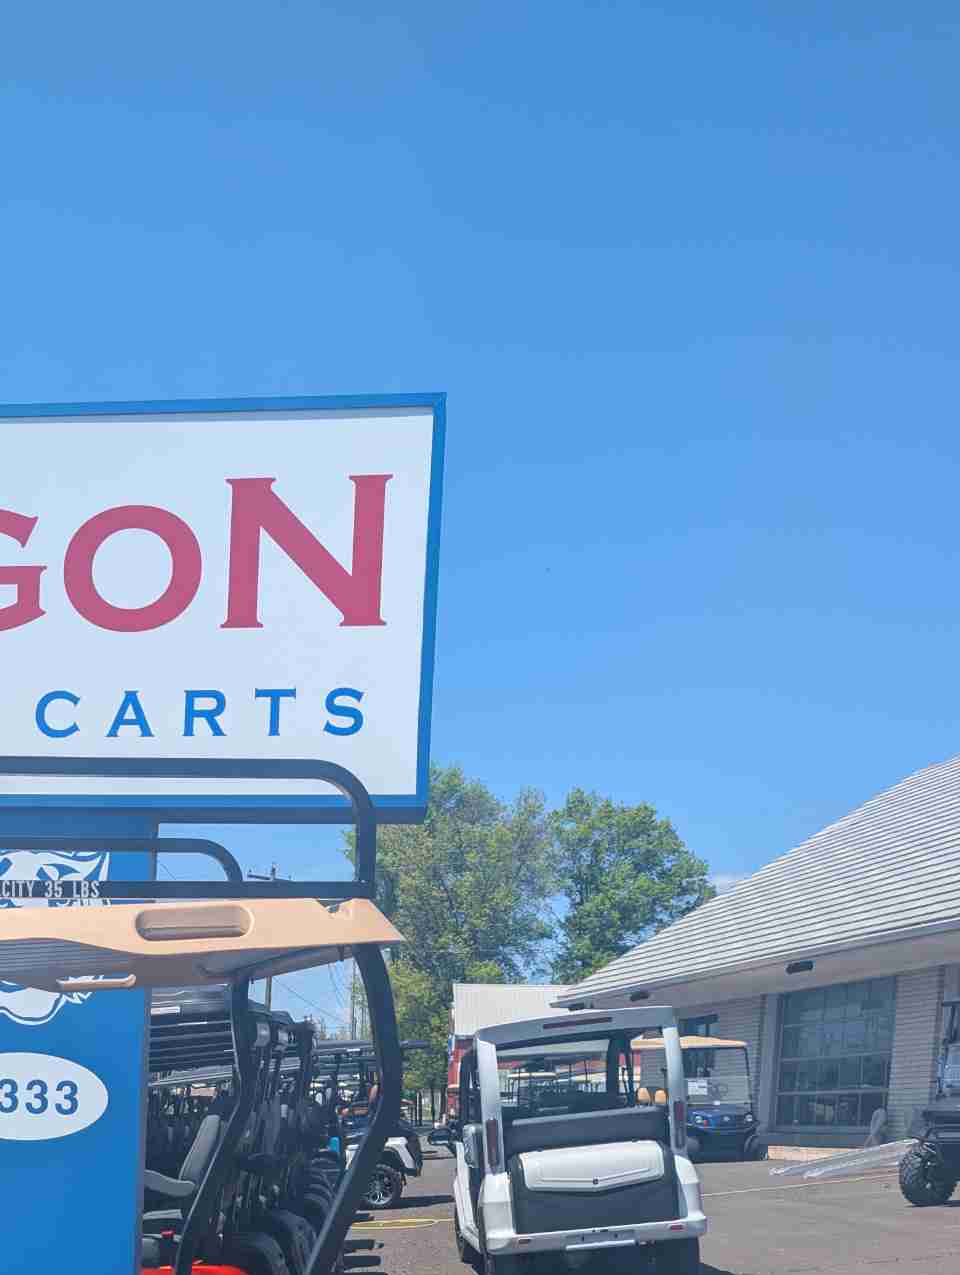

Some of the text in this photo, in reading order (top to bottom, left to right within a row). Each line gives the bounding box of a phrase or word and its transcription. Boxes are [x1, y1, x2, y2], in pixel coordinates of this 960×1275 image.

[34, 687, 365, 738] CARTS
[44, 881, 63, 897] 35
[72, 881, 100, 898] LBS
